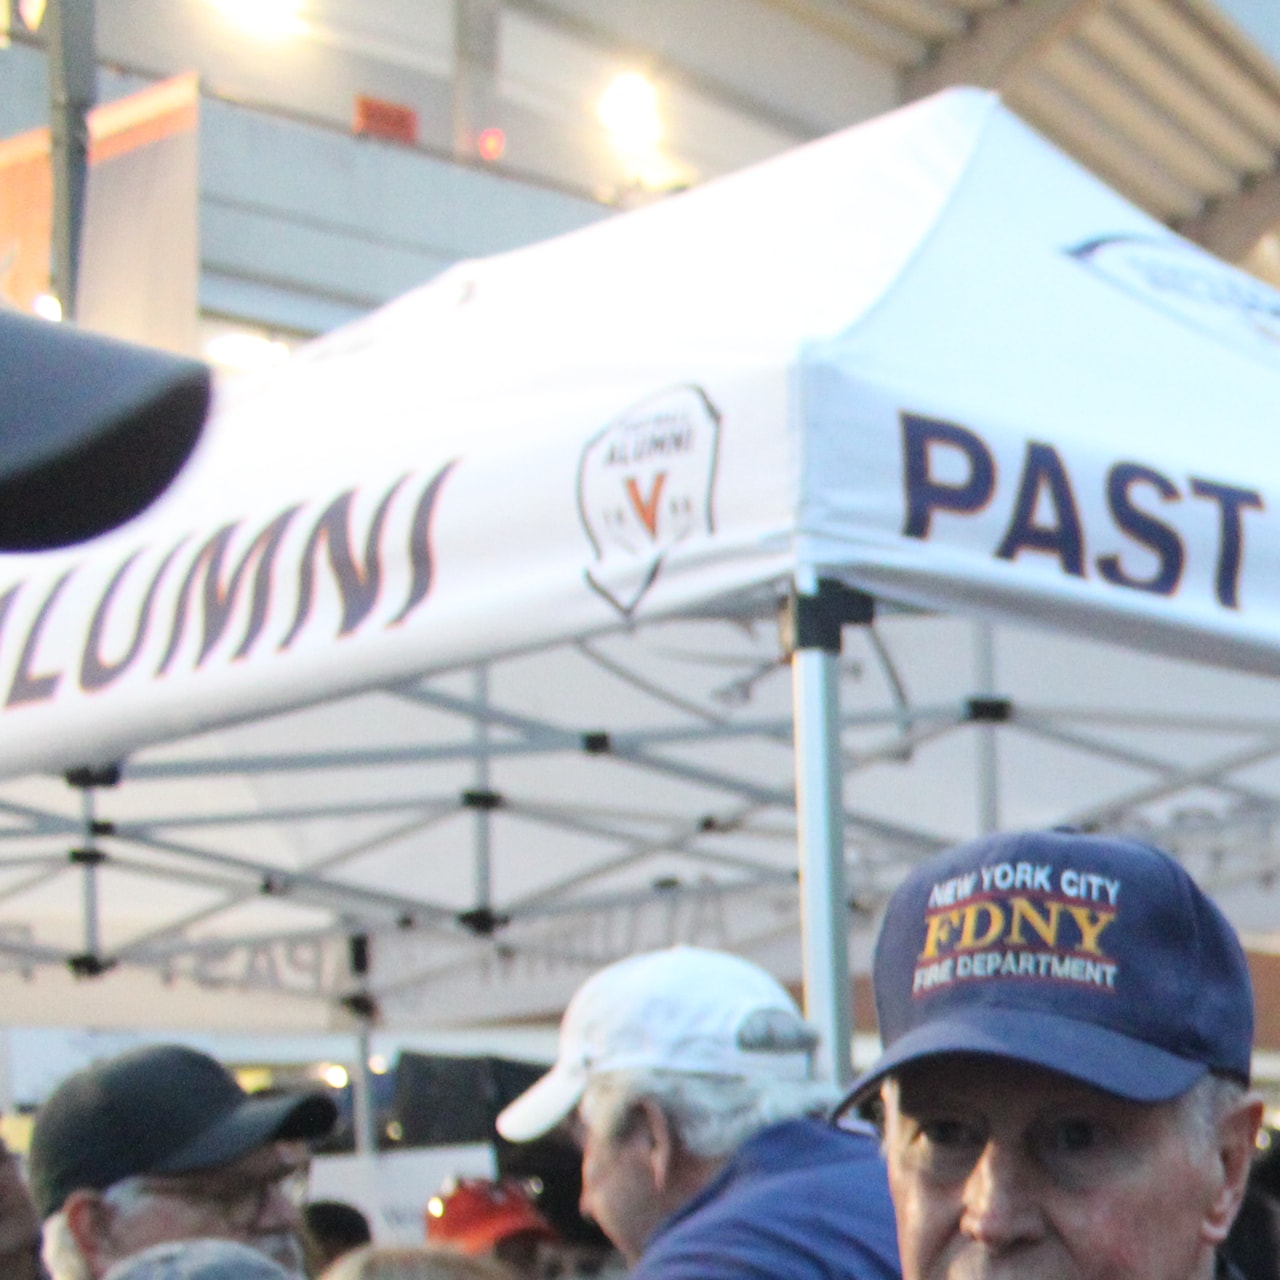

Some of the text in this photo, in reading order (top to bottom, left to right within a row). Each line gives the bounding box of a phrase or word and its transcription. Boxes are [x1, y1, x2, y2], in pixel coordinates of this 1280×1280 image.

[625, 471, 668, 541] V
[897, 408, 1266, 613] PAST
[927, 861, 1122, 908] NEW YORK CITY
[918, 896, 1119, 960] FDNY
[912, 948, 1119, 993] FIRE DEPARTMENT
